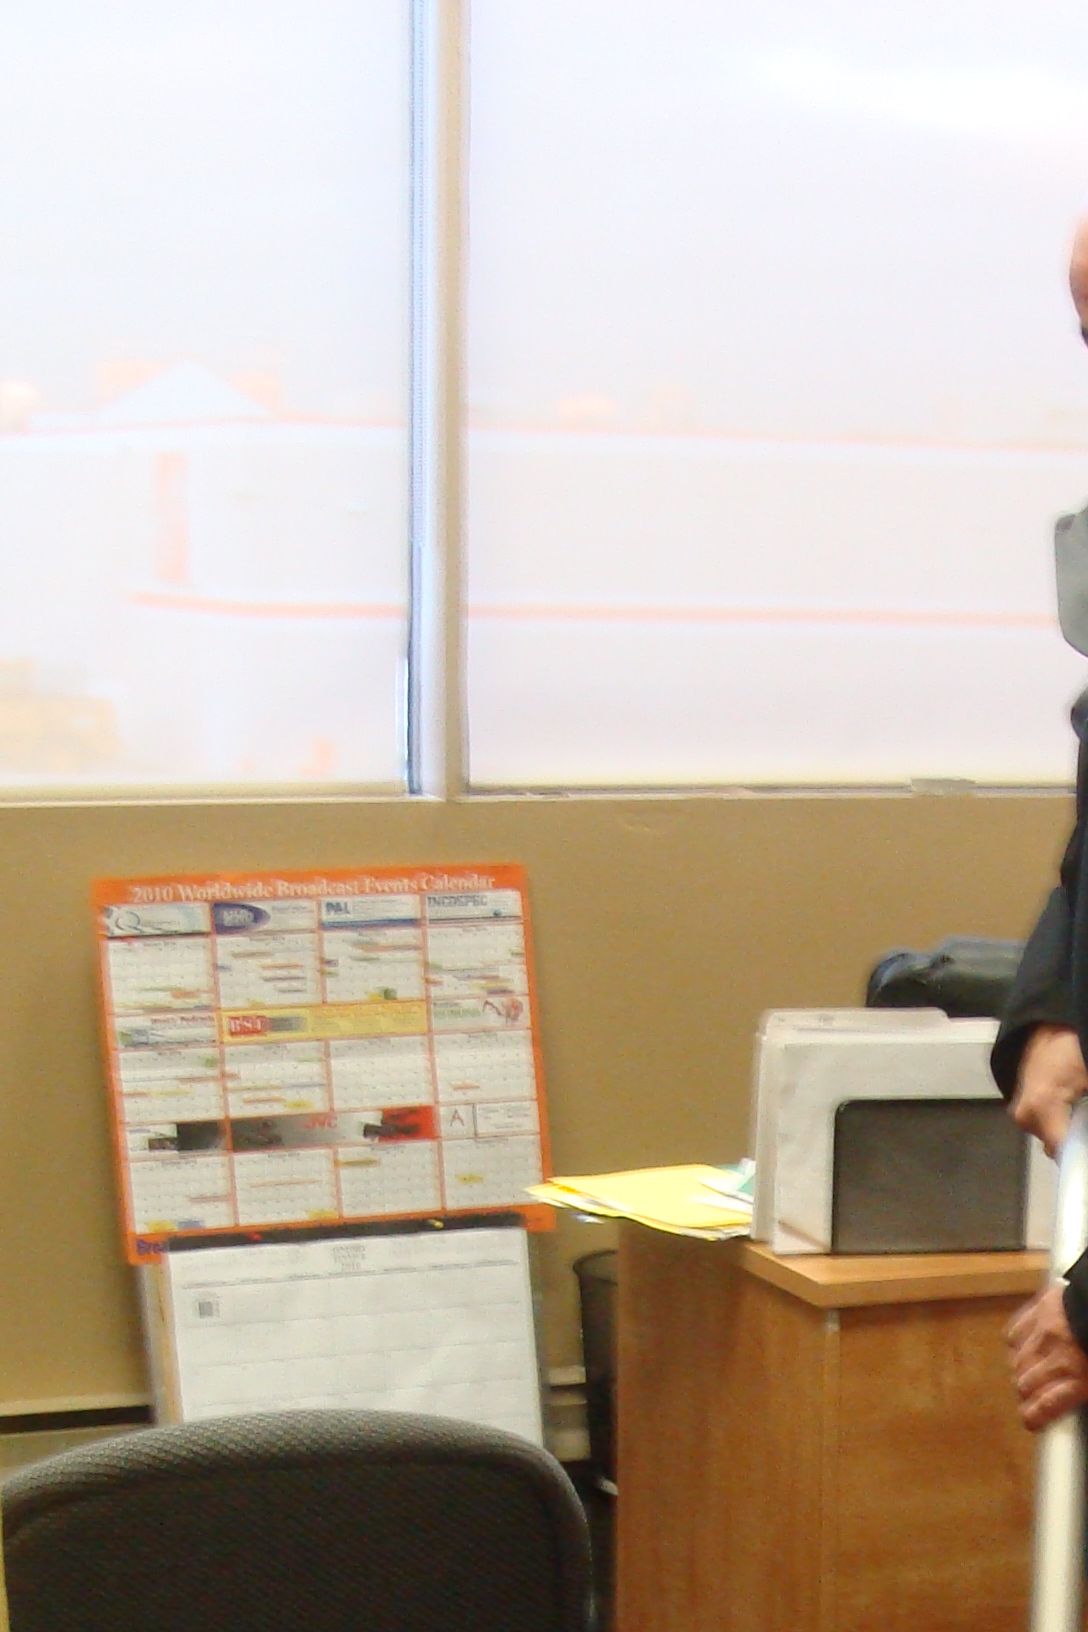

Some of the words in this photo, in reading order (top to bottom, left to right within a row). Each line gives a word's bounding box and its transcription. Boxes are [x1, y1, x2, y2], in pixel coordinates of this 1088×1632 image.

[132, 885, 174, 903] 2010
[178, 880, 273, 902] Worldwide
[277, 876, 360, 898] Broadcast
[363, 875, 418, 895] Events
[422, 872, 496, 891] Calendar
[325, 902, 350, 915] PAL
